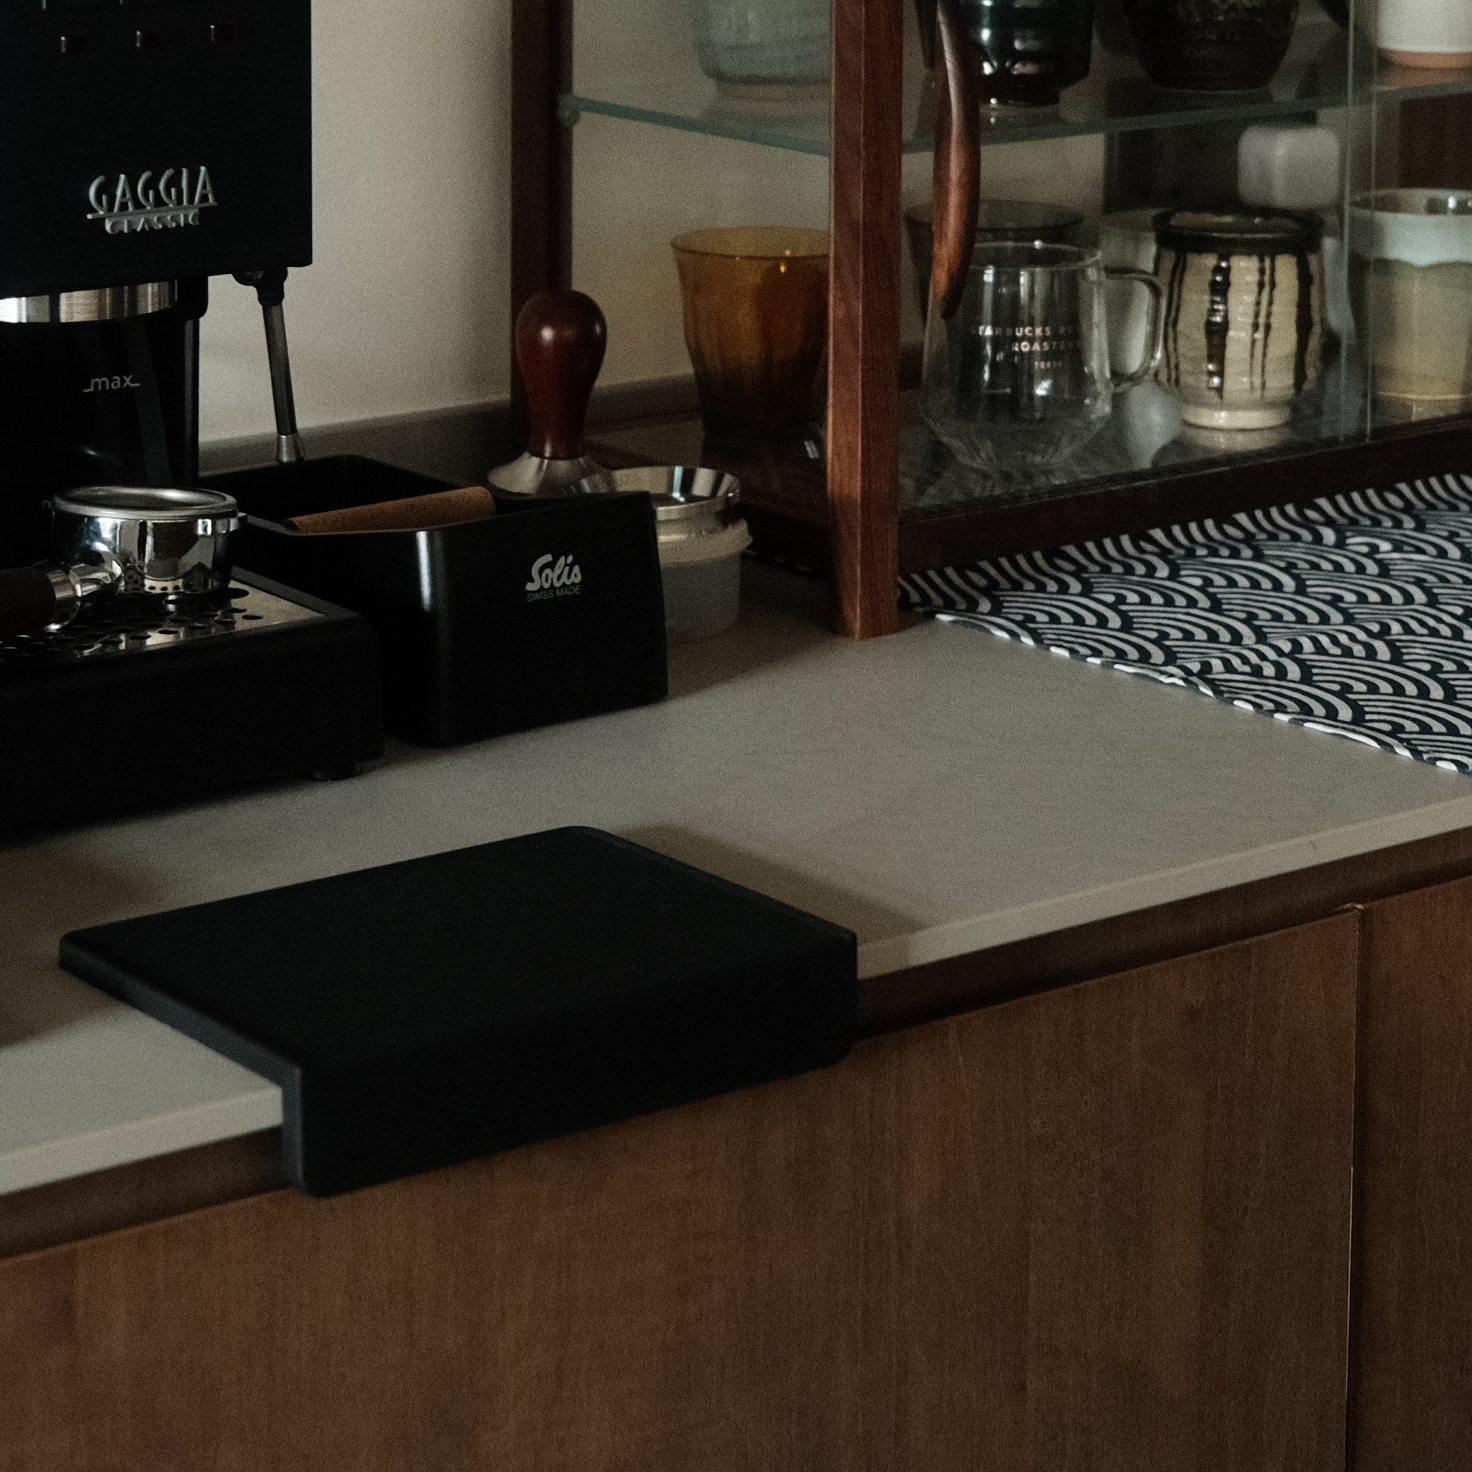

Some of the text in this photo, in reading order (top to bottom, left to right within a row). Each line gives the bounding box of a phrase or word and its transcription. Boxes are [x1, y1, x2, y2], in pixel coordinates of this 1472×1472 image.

[88, 165, 217, 215] GAGGIA
[105, 211, 201, 235] CLASSIC
[90, 373, 135, 392] max
[524, 552, 583, 591] Solis
[526, 585, 582, 603] SWISS MADE
